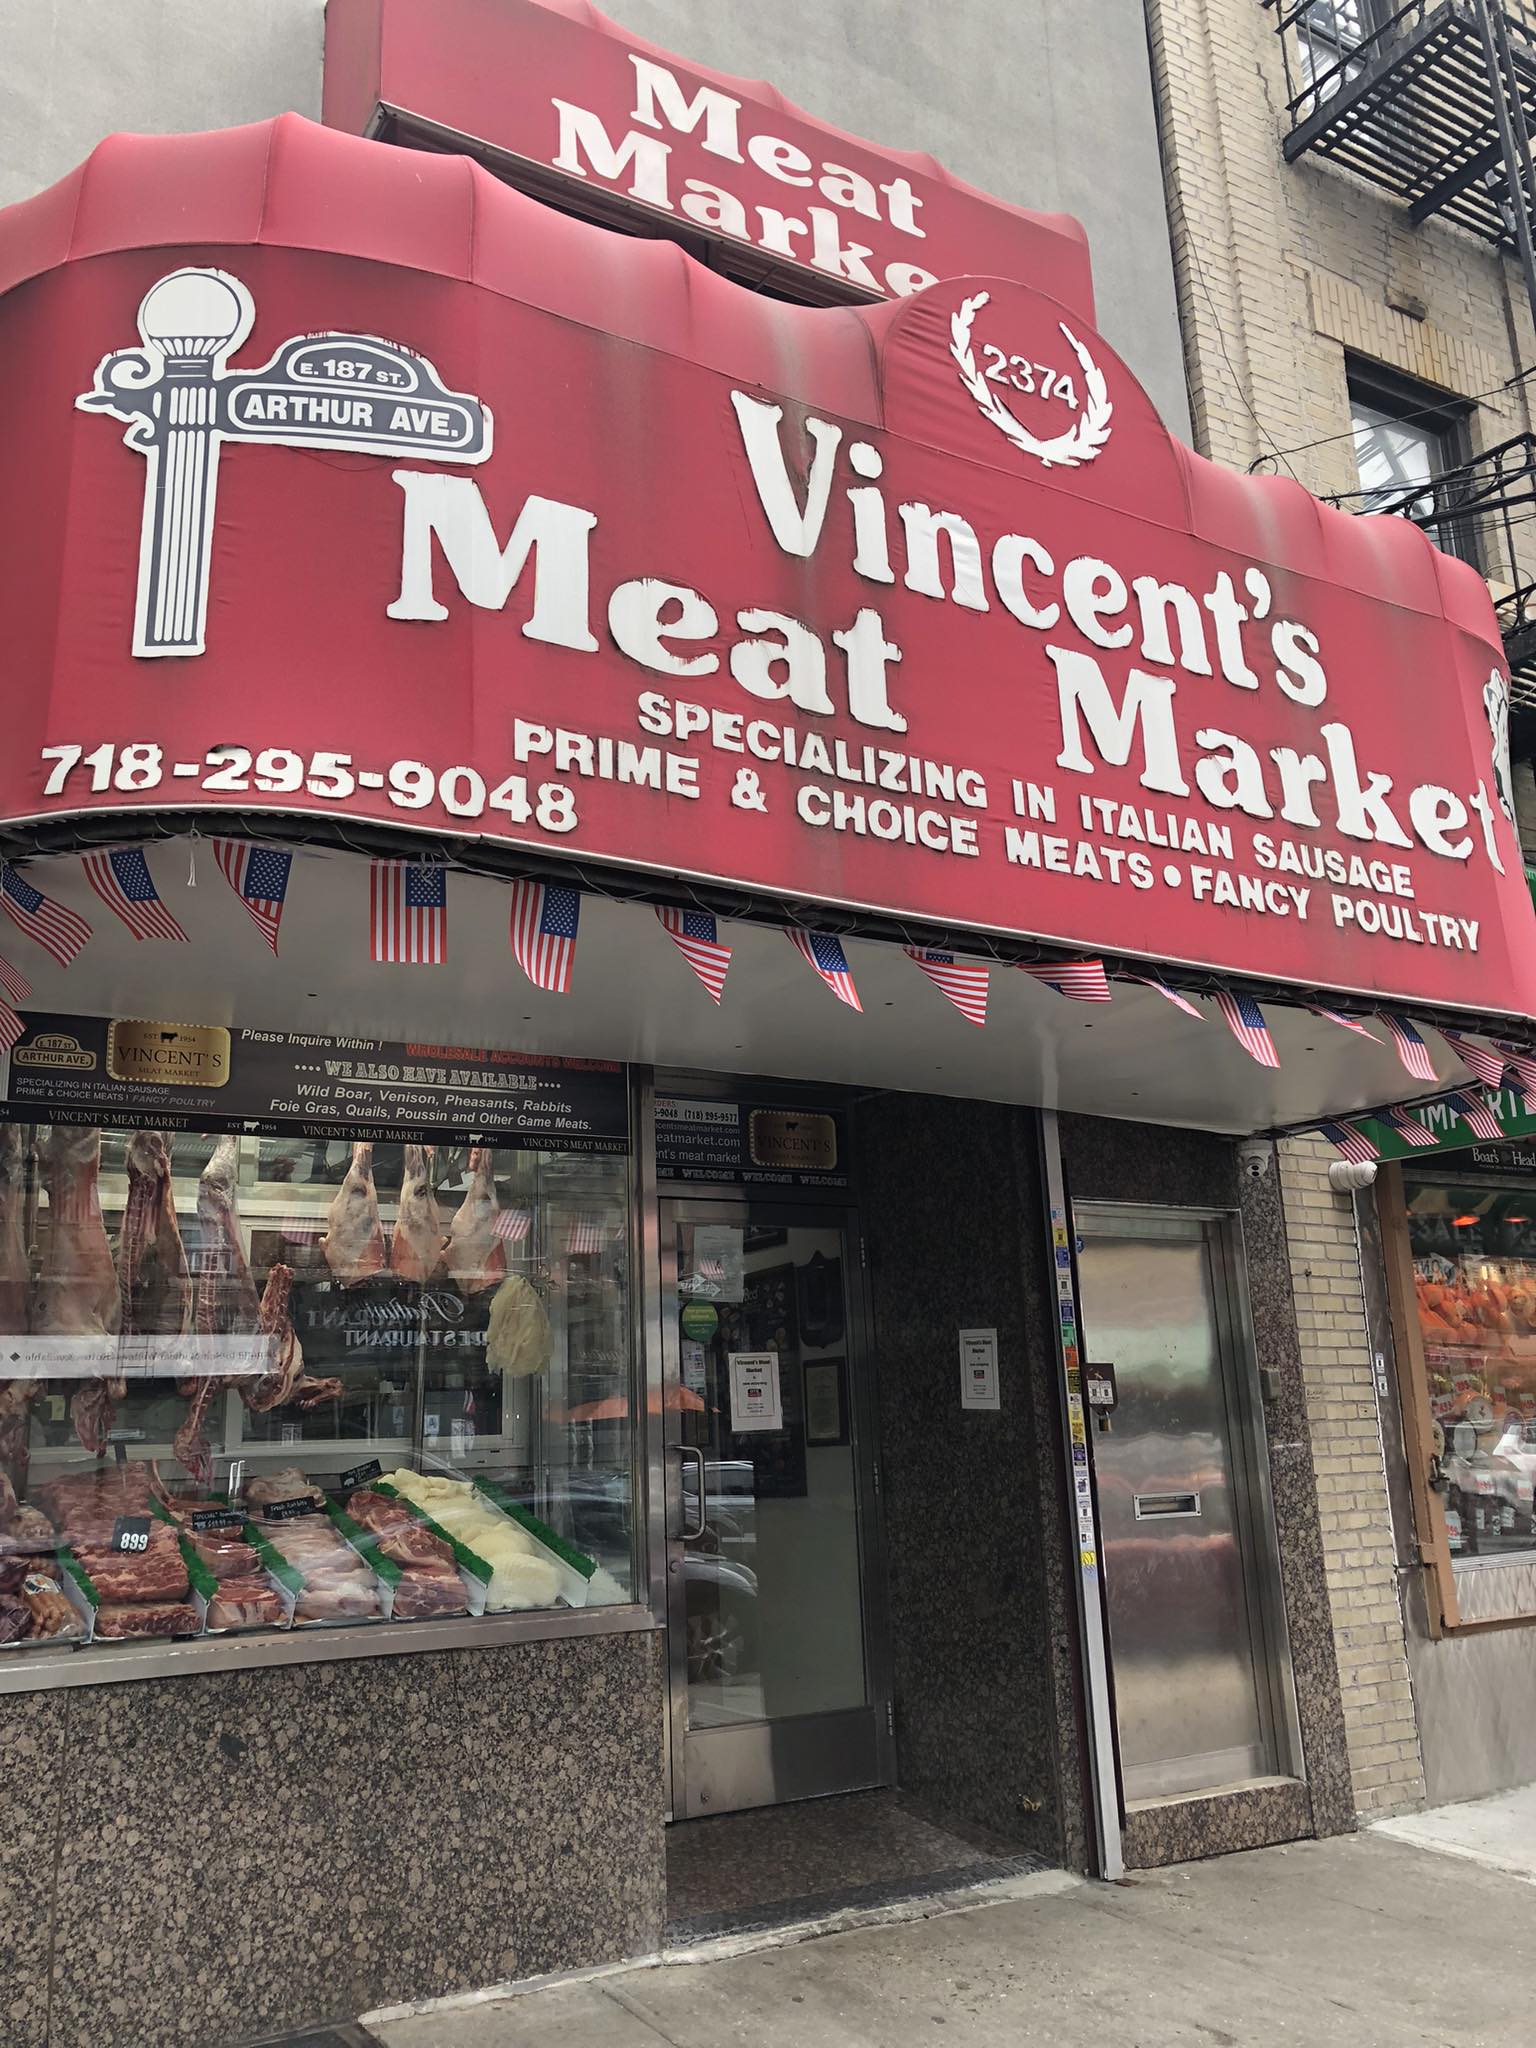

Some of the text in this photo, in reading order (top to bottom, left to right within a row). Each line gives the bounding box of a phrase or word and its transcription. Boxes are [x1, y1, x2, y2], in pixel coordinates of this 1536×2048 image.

[628, 54, 926, 238] Meat
[551, 97, 940, 299] Marke
[300, 358, 405, 386] E. 187 ST.
[982, 344, 1080, 409] 2374
[244, 395, 459, 437] ARTHUR AVE.
[731, 389, 1327, 707] Vincent's
[386, 469, 1506, 877] Meat Market
[41, 743, 579, 832] 718-295-9048
[637, 690, 1416, 899] SPECIALIZING IN ITALIAN SAUSAGE
[514, 718, 1481, 953] PRIME & CHOICE MEATS FANCY POULTRY
[47, 1038, 63, 1050] 187
[241, 1029, 284, 1043] Please
[288, 1033, 332, 1049] Inquire
[335, 1037, 375, 1051] Within
[21, 1051, 89, 1065] ARTHUR AVE.
[324, 1060, 352, 1077] WE
[355, 1063, 400, 1080] ALSO
[403, 1066, 447, 1084] HAVE
[16, 1077, 170, 1095] SPECIALIZING IN ITALIAN SAUSAGE
[16, 1086, 45, 1097] PRIME
[47, 1088, 54, 1097] &
[55, 1089, 91, 1100] CHOICE
[93, 1091, 125, 1102] MEATS
[132, 1095, 167, 1106] FANCY
[169, 1097, 216, 1109] POULTRY
[297, 1083, 573, 1114] Wild Boar, Venison, Pheasants, Rabbits
[49, 1110, 189, 1128] VINCENT'S MEAT MARKET
[227, 1122, 241, 1130] EST
[270, 1099, 592, 1130] Foie Gras, Quails, Poussin and Other Game Meats.
[684, 1108, 704, 1121] (718)
[302, 1125, 424, 1142] VINCENT'S MEAT MARKET
[570, 1140, 593, 1150] MEAT
[679, 1151, 704, 1162] meat
[706, 1152, 741, 1164] market
[1472, 1147, 1536, 1167] Boar's Head
[682, 1168, 735, 1181] WELCOME
[743, 1171, 793, 1184] WELCOME
